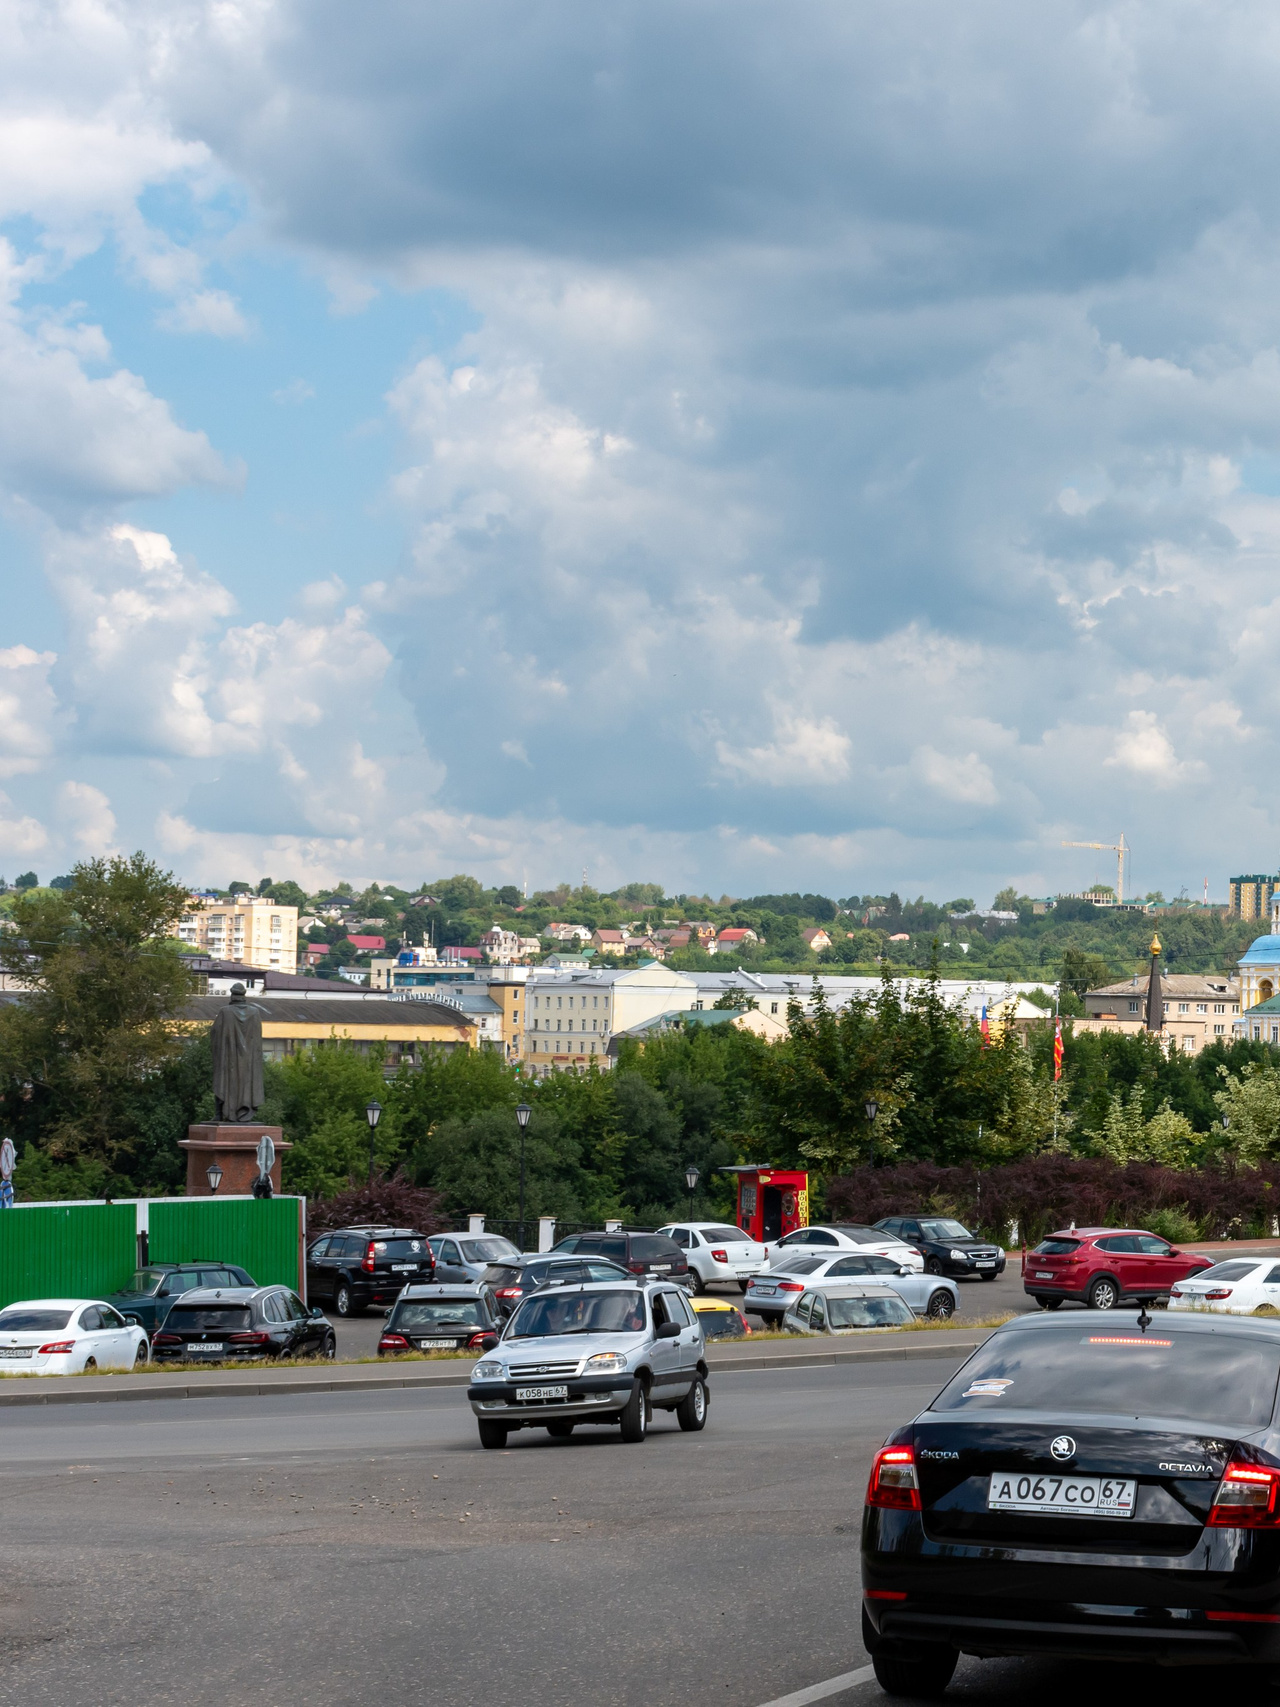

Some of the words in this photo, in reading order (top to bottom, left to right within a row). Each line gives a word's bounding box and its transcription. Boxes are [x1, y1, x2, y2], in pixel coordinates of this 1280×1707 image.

[1159, 1462, 1214, 1473] OCTAVIA
[1102, 1480, 1127, 1500] 67
[1099, 1499, 1118, 1507] RUS
